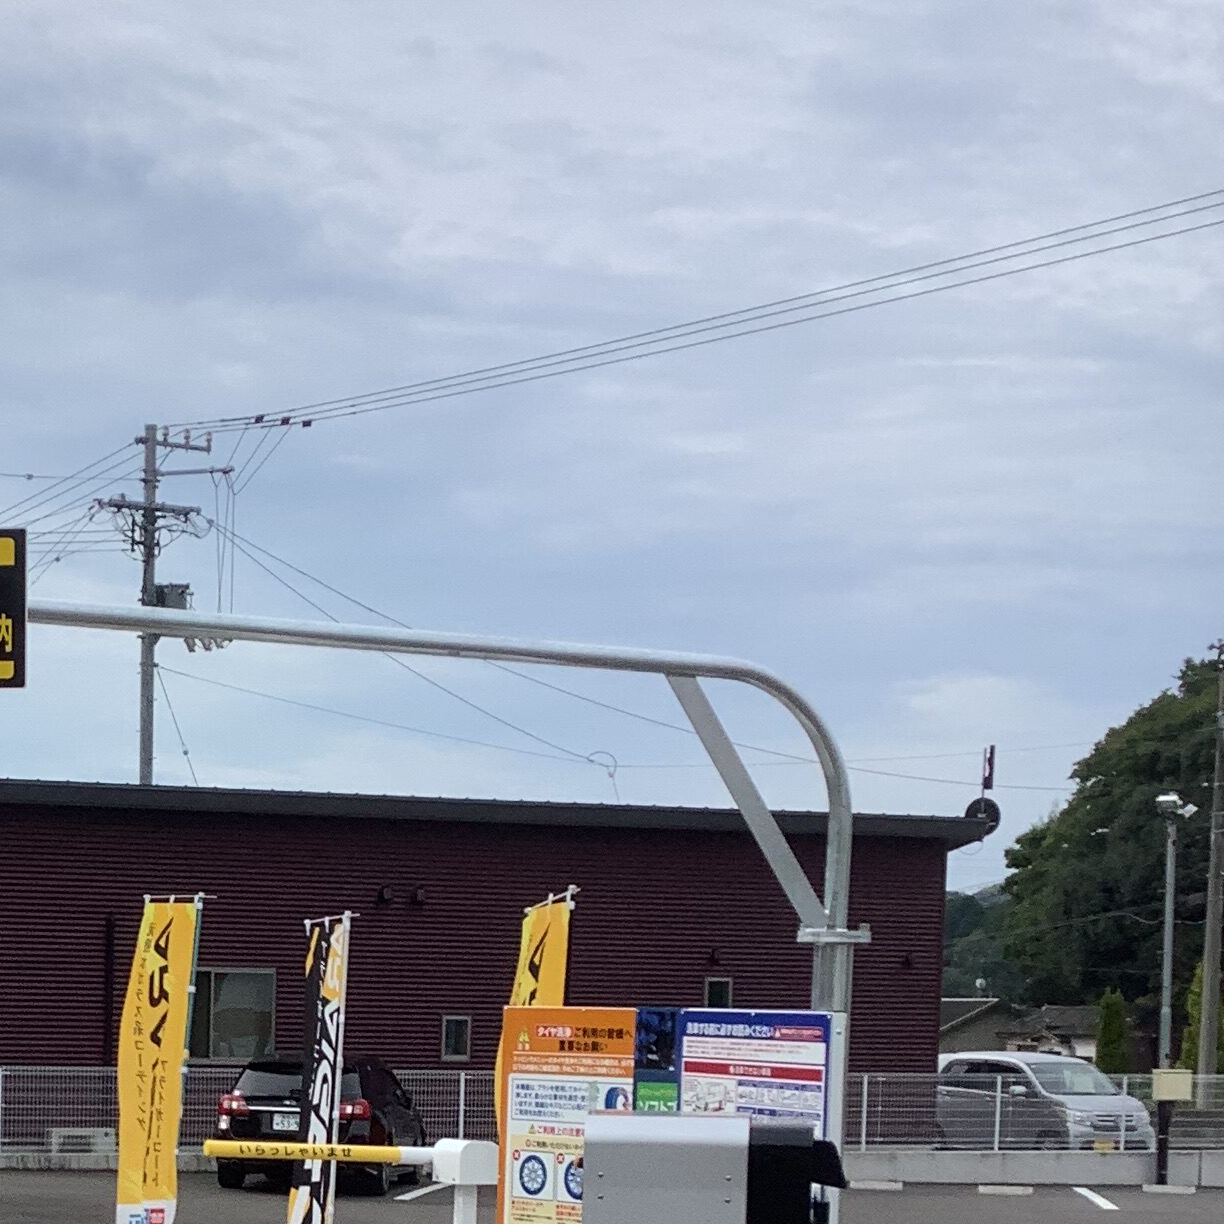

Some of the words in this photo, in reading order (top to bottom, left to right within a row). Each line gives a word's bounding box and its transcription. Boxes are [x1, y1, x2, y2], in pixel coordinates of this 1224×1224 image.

[239, 1144, 352, 1158] いらっしゃいませ
